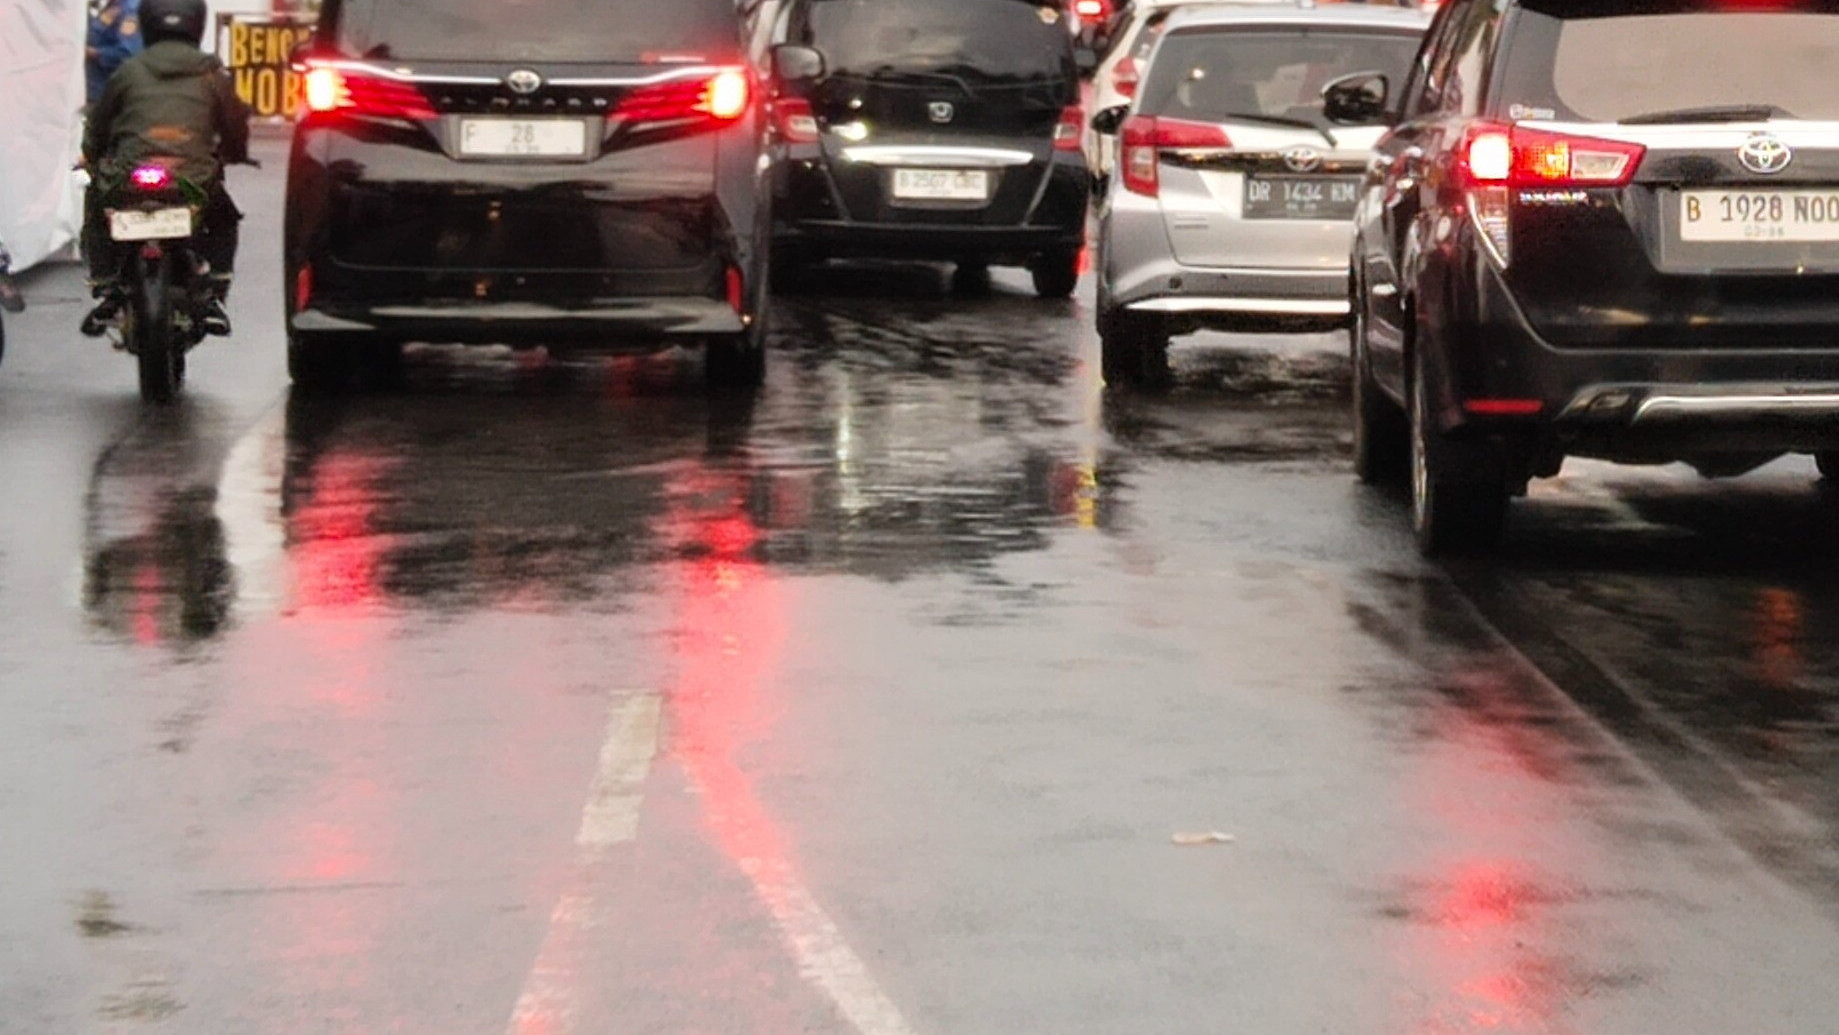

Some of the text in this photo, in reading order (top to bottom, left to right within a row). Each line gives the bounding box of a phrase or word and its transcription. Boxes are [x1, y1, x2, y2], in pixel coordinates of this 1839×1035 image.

[465, 123, 535, 143] F 28
[1248, 179, 1271, 202] DR
[1686, 195, 1701, 223] B
[1719, 194, 1783, 223] 1928
